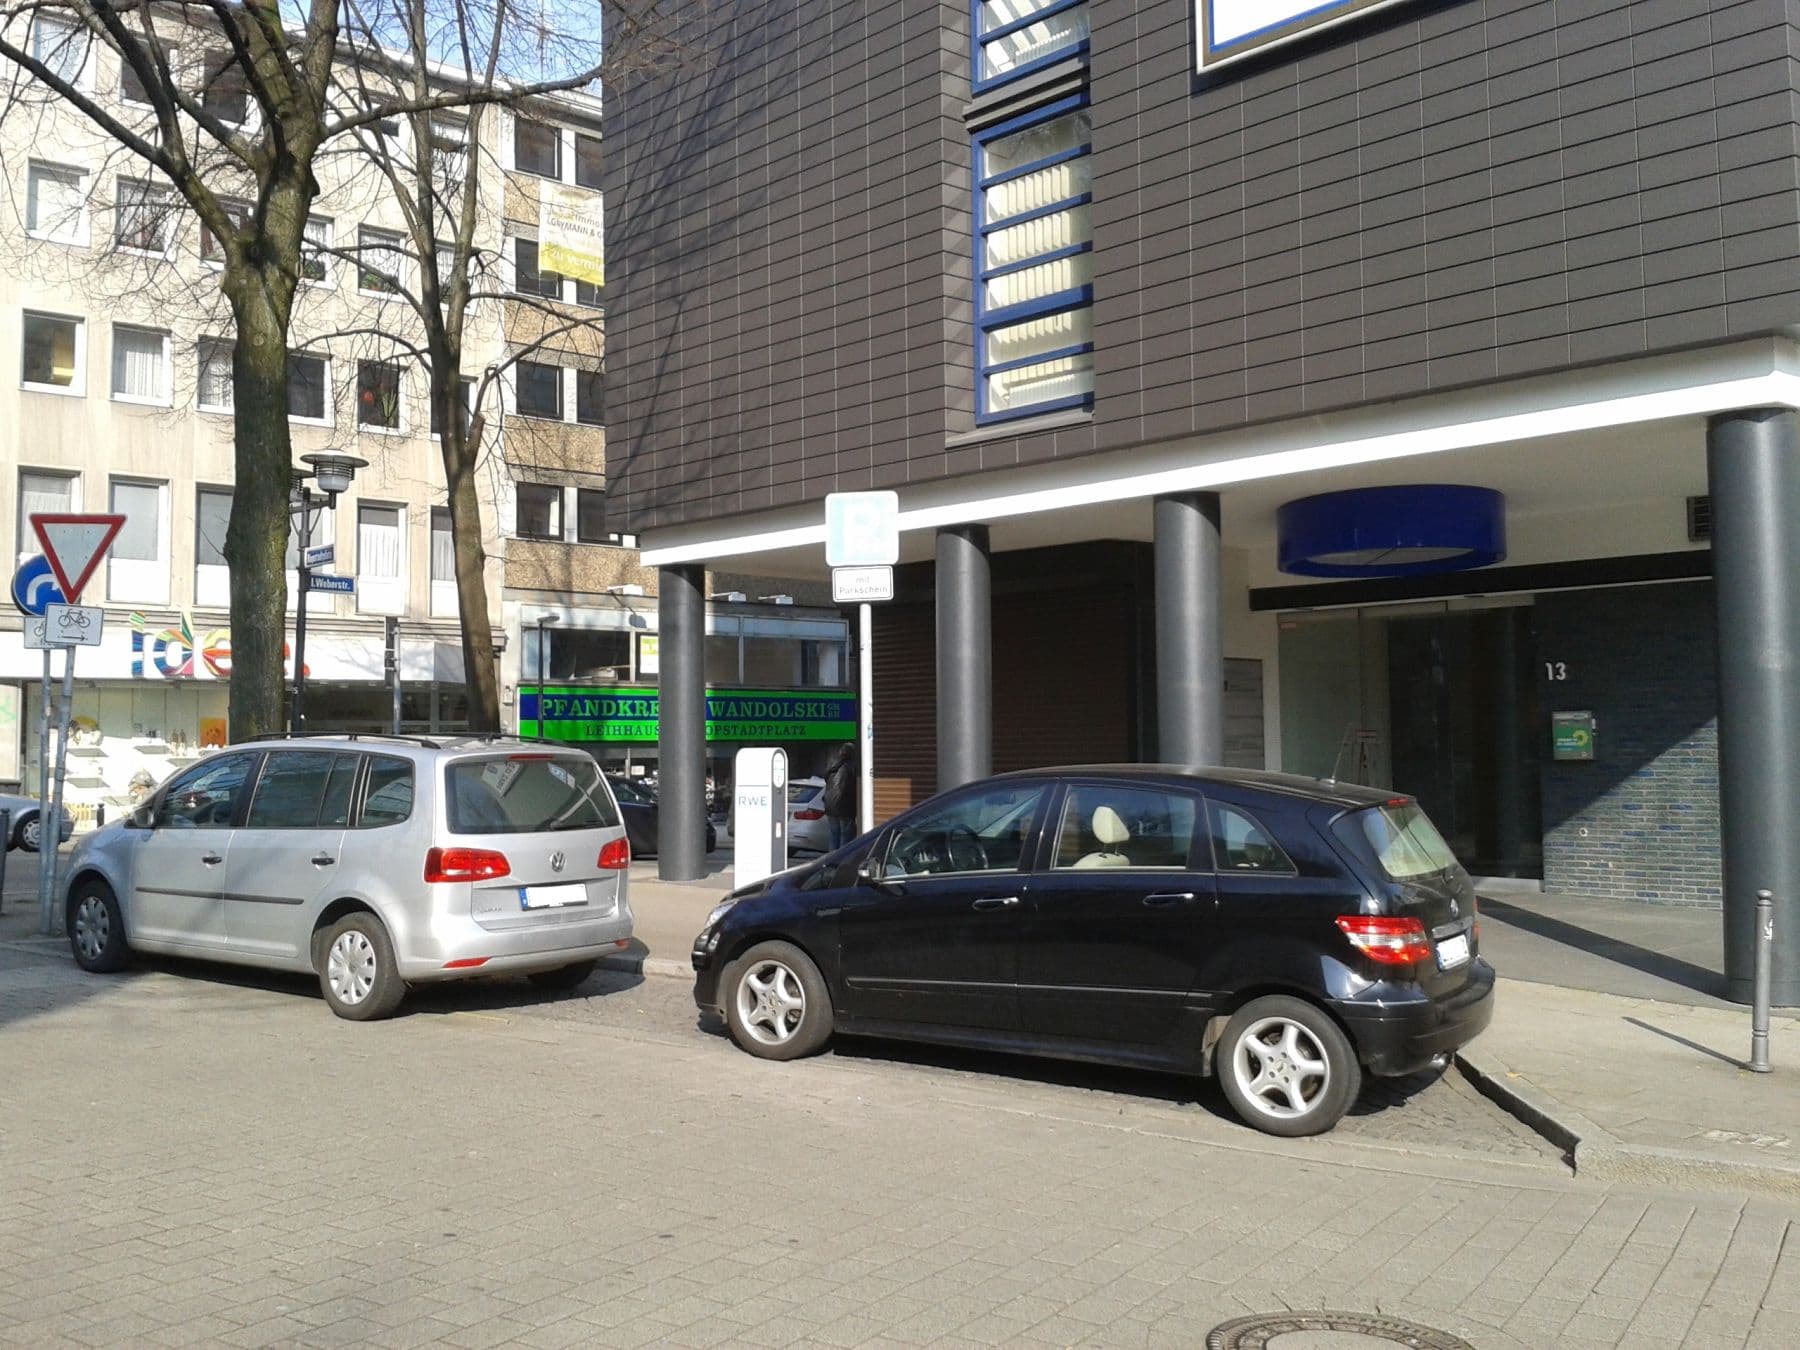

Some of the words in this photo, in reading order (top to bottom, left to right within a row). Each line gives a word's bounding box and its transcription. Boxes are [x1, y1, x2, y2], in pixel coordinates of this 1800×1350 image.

[839, 586, 888, 595] Parkschein
[1545, 661, 1566, 681] 13
[543, 699, 659, 718] PFANDKRE
[708, 701, 827, 718] WANDOLSKI
[706, 725, 806, 737] OPSTADTPLATZ
[738, 796, 768, 806] RWE
